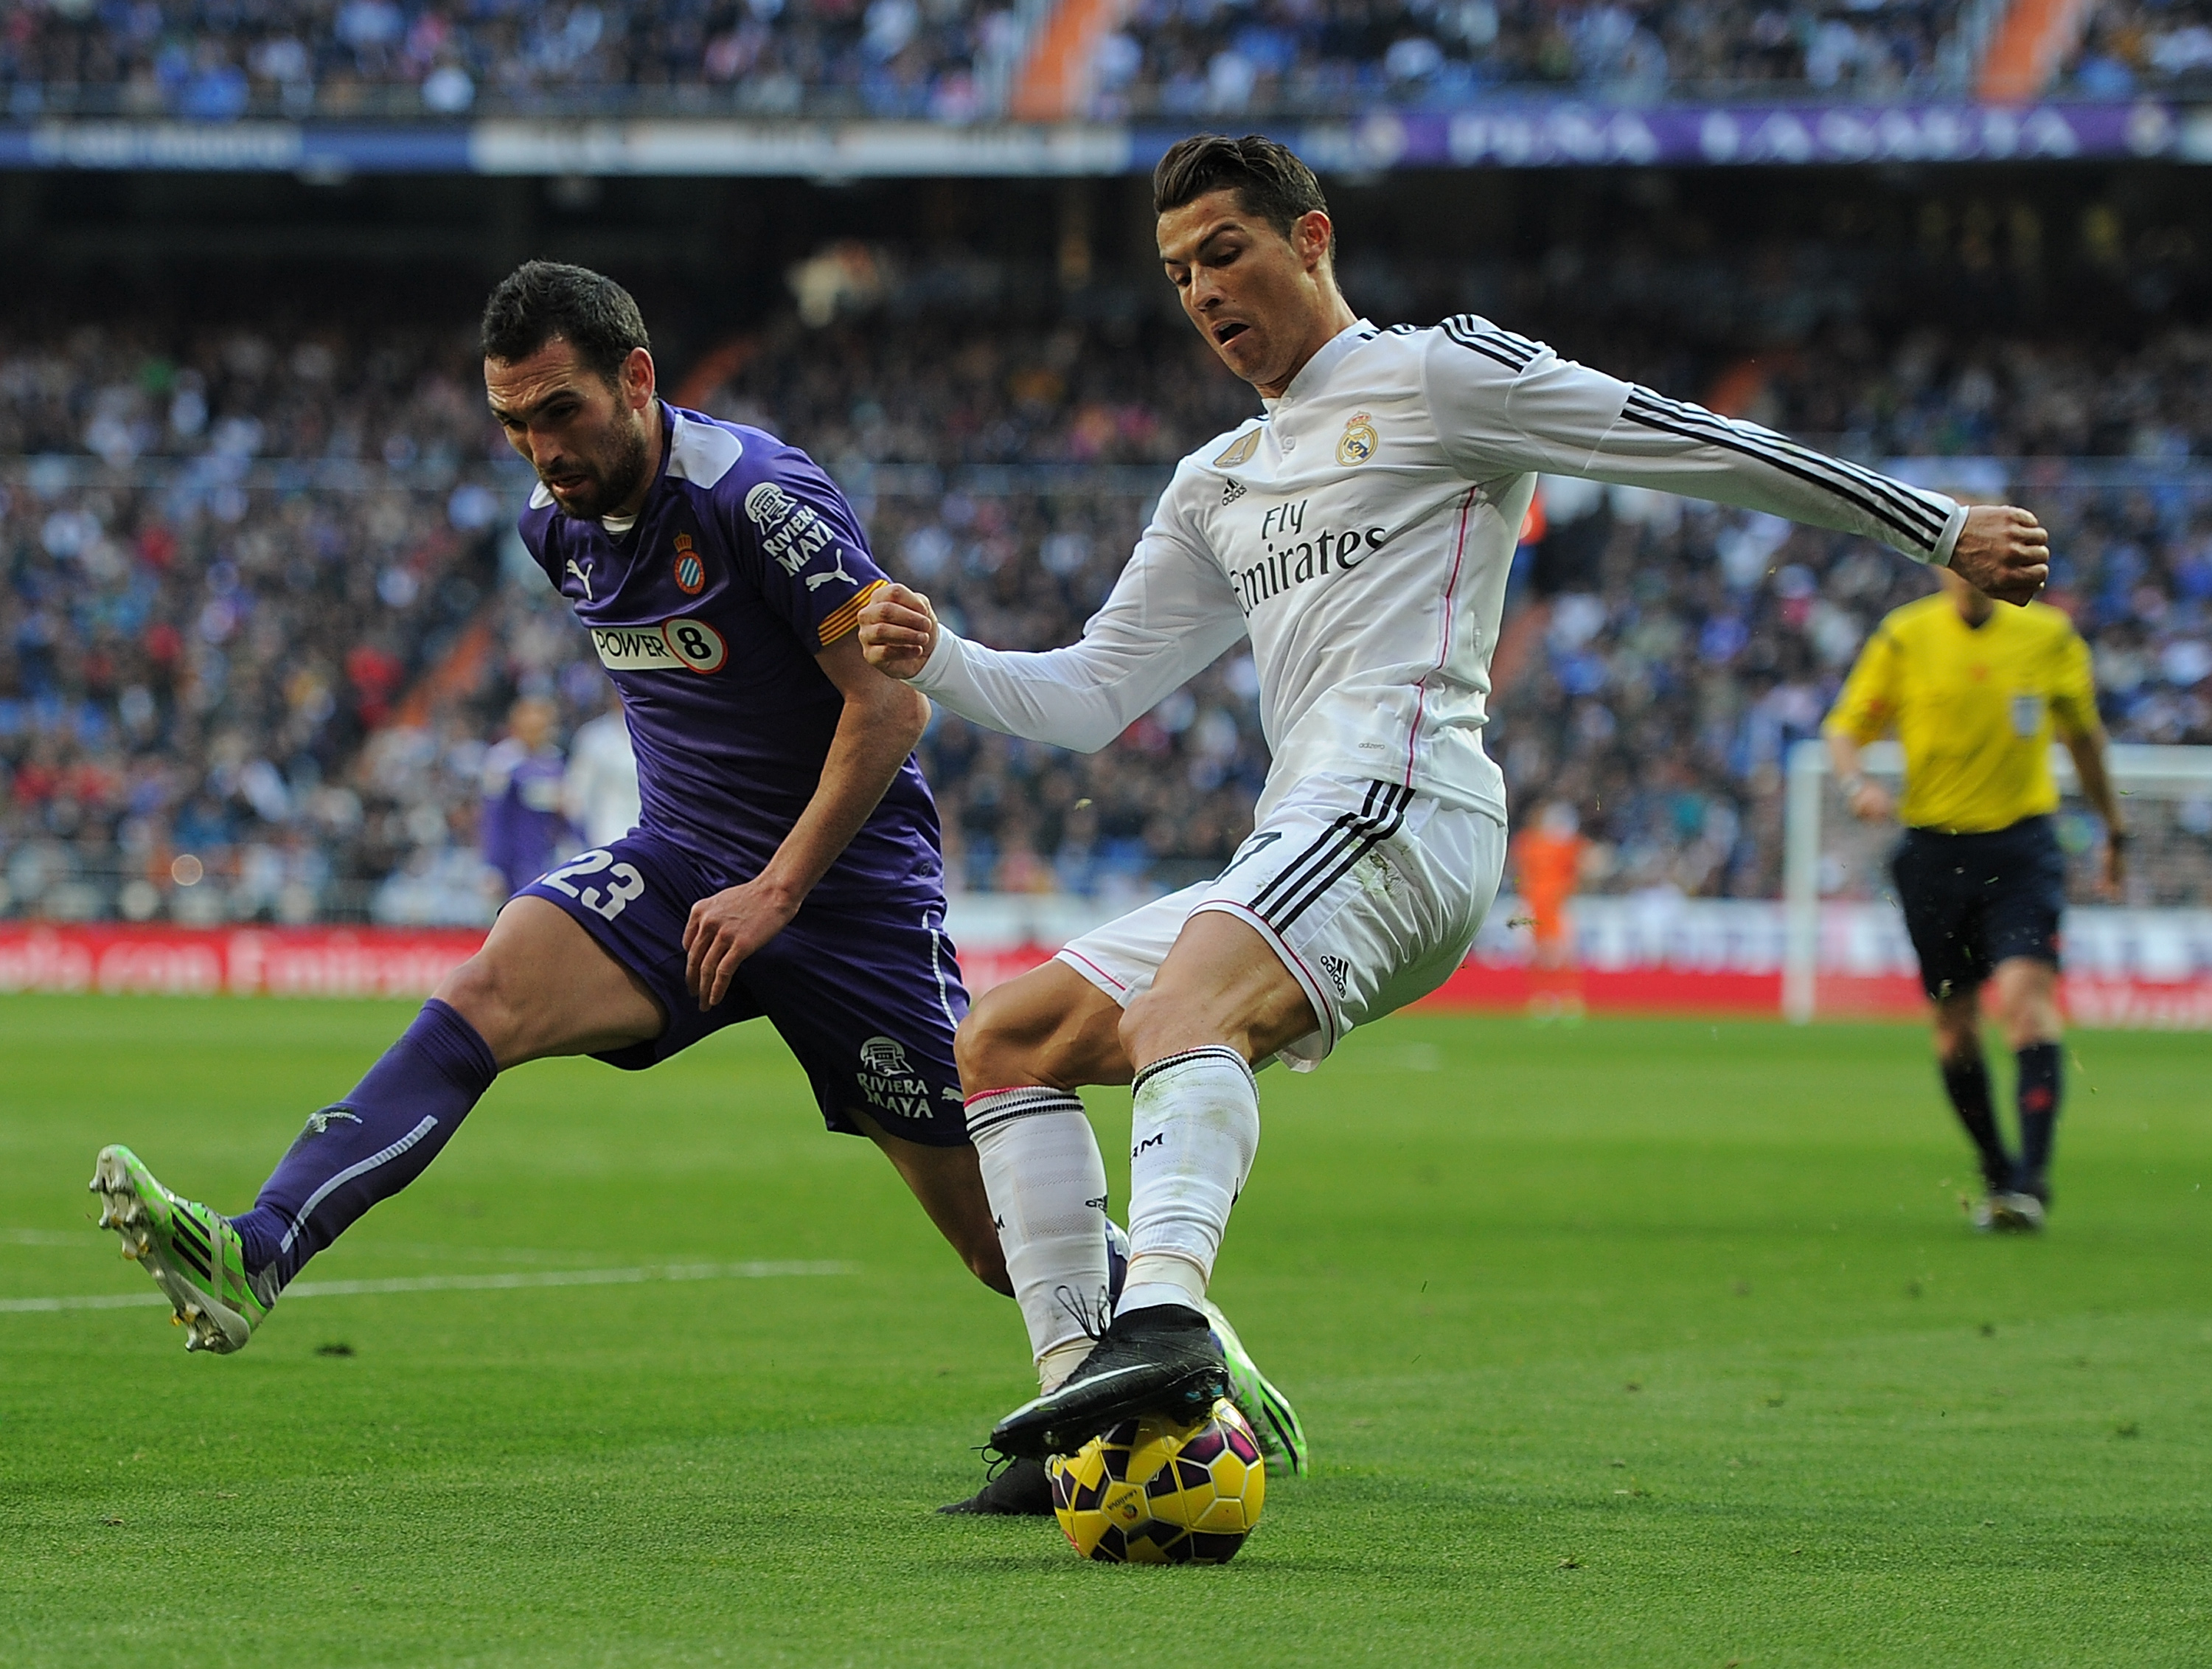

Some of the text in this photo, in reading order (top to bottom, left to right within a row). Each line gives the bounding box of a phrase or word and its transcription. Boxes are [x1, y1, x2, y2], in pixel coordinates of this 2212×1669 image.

[762, 504, 819, 558] RIVIERA
[1262, 499, 1309, 541] Fly
[774, 519, 835, 577] MAYA
[595, 626, 712, 660] POWER 8
[1358, 741, 1385, 750] adizero
[1209, 831, 1282, 886] 7
[541, 848, 645, 922] 23
[1320, 955, 1346, 999] adidas
[857, 1072, 929, 1095] RIVIERA
[865, 1088, 934, 1119] MAYA
